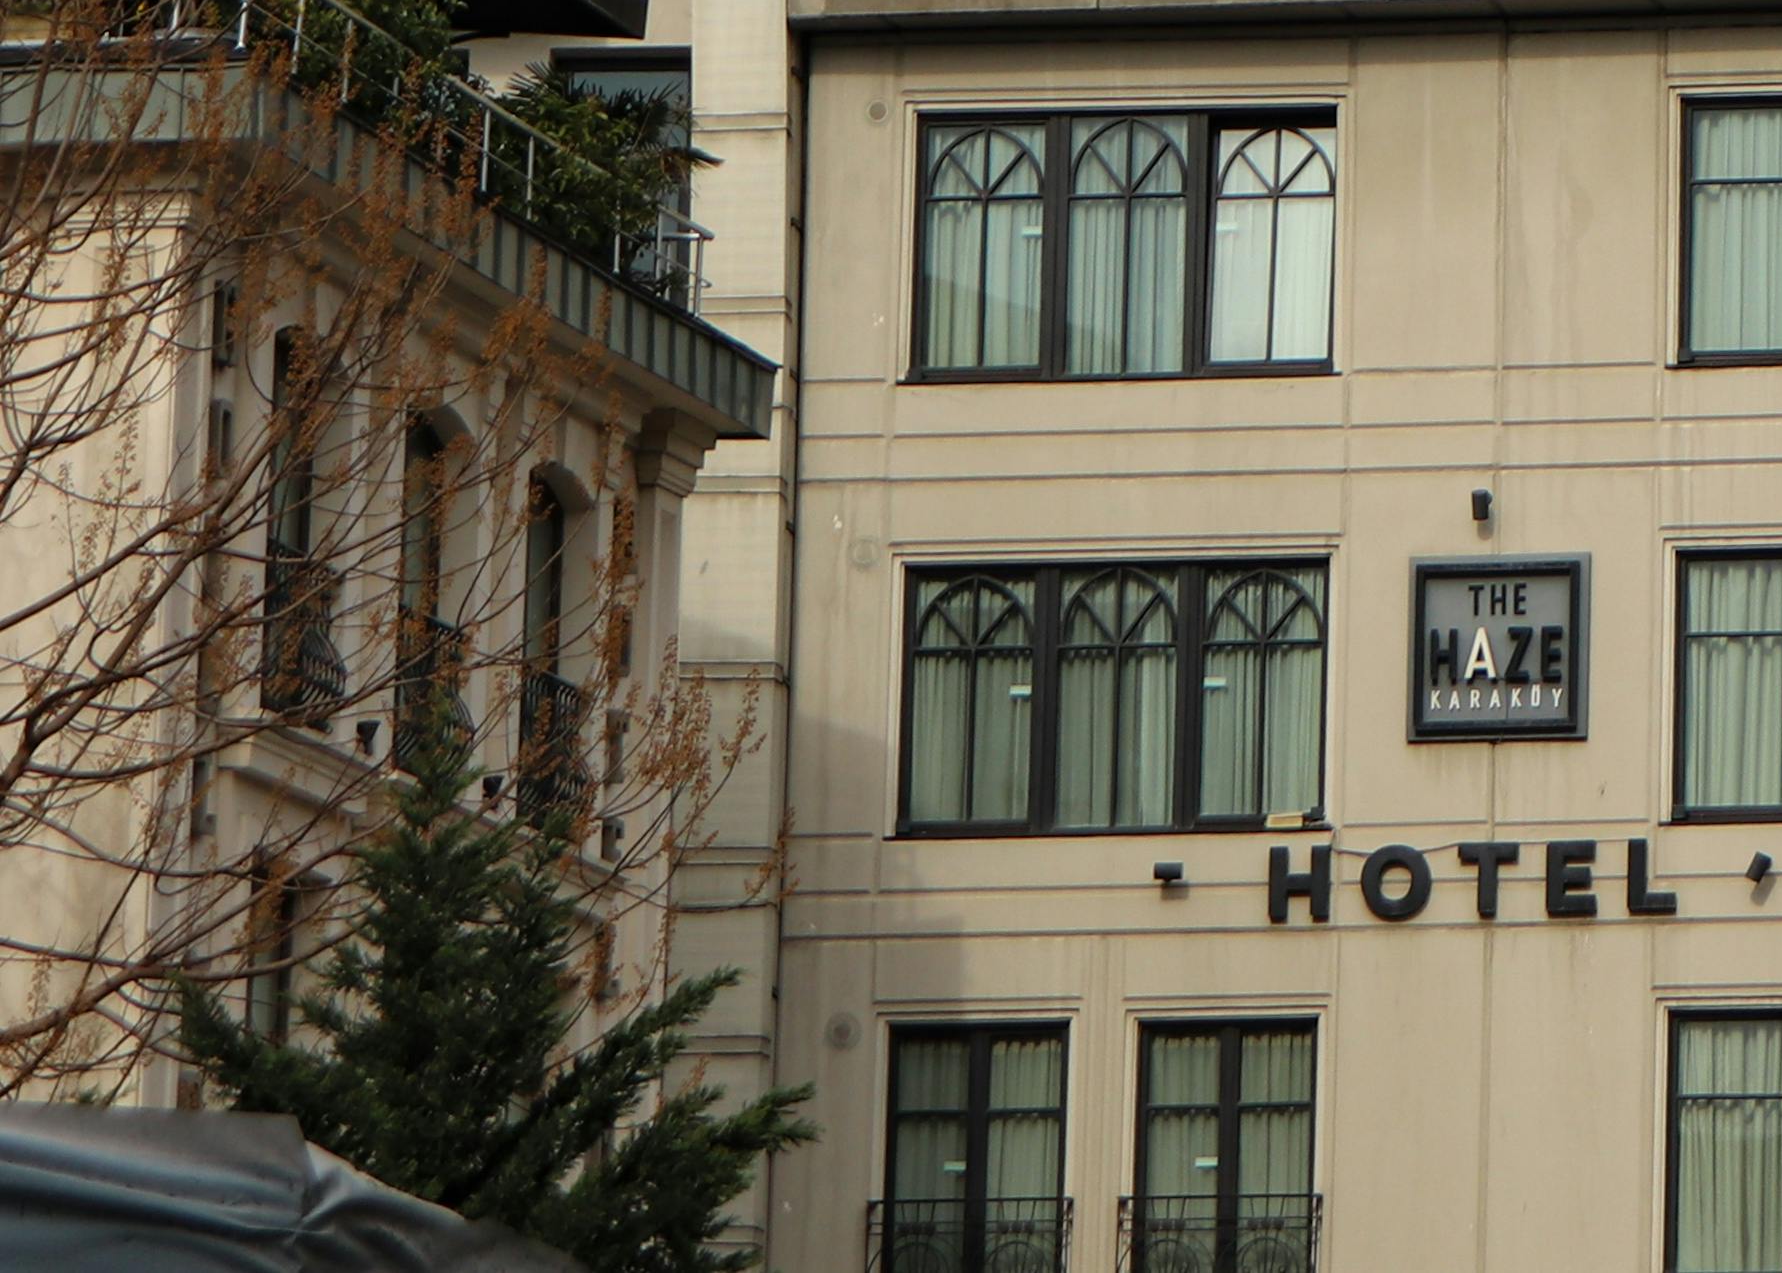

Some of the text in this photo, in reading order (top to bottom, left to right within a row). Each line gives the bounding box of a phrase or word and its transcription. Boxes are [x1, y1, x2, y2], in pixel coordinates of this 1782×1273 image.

[1467, 582, 1527, 617] THE
[1430, 625, 1564, 686] HAZE
[1430, 684, 1564, 711] KARAKÖY
[1268, 837, 1678, 924] HOTEL
